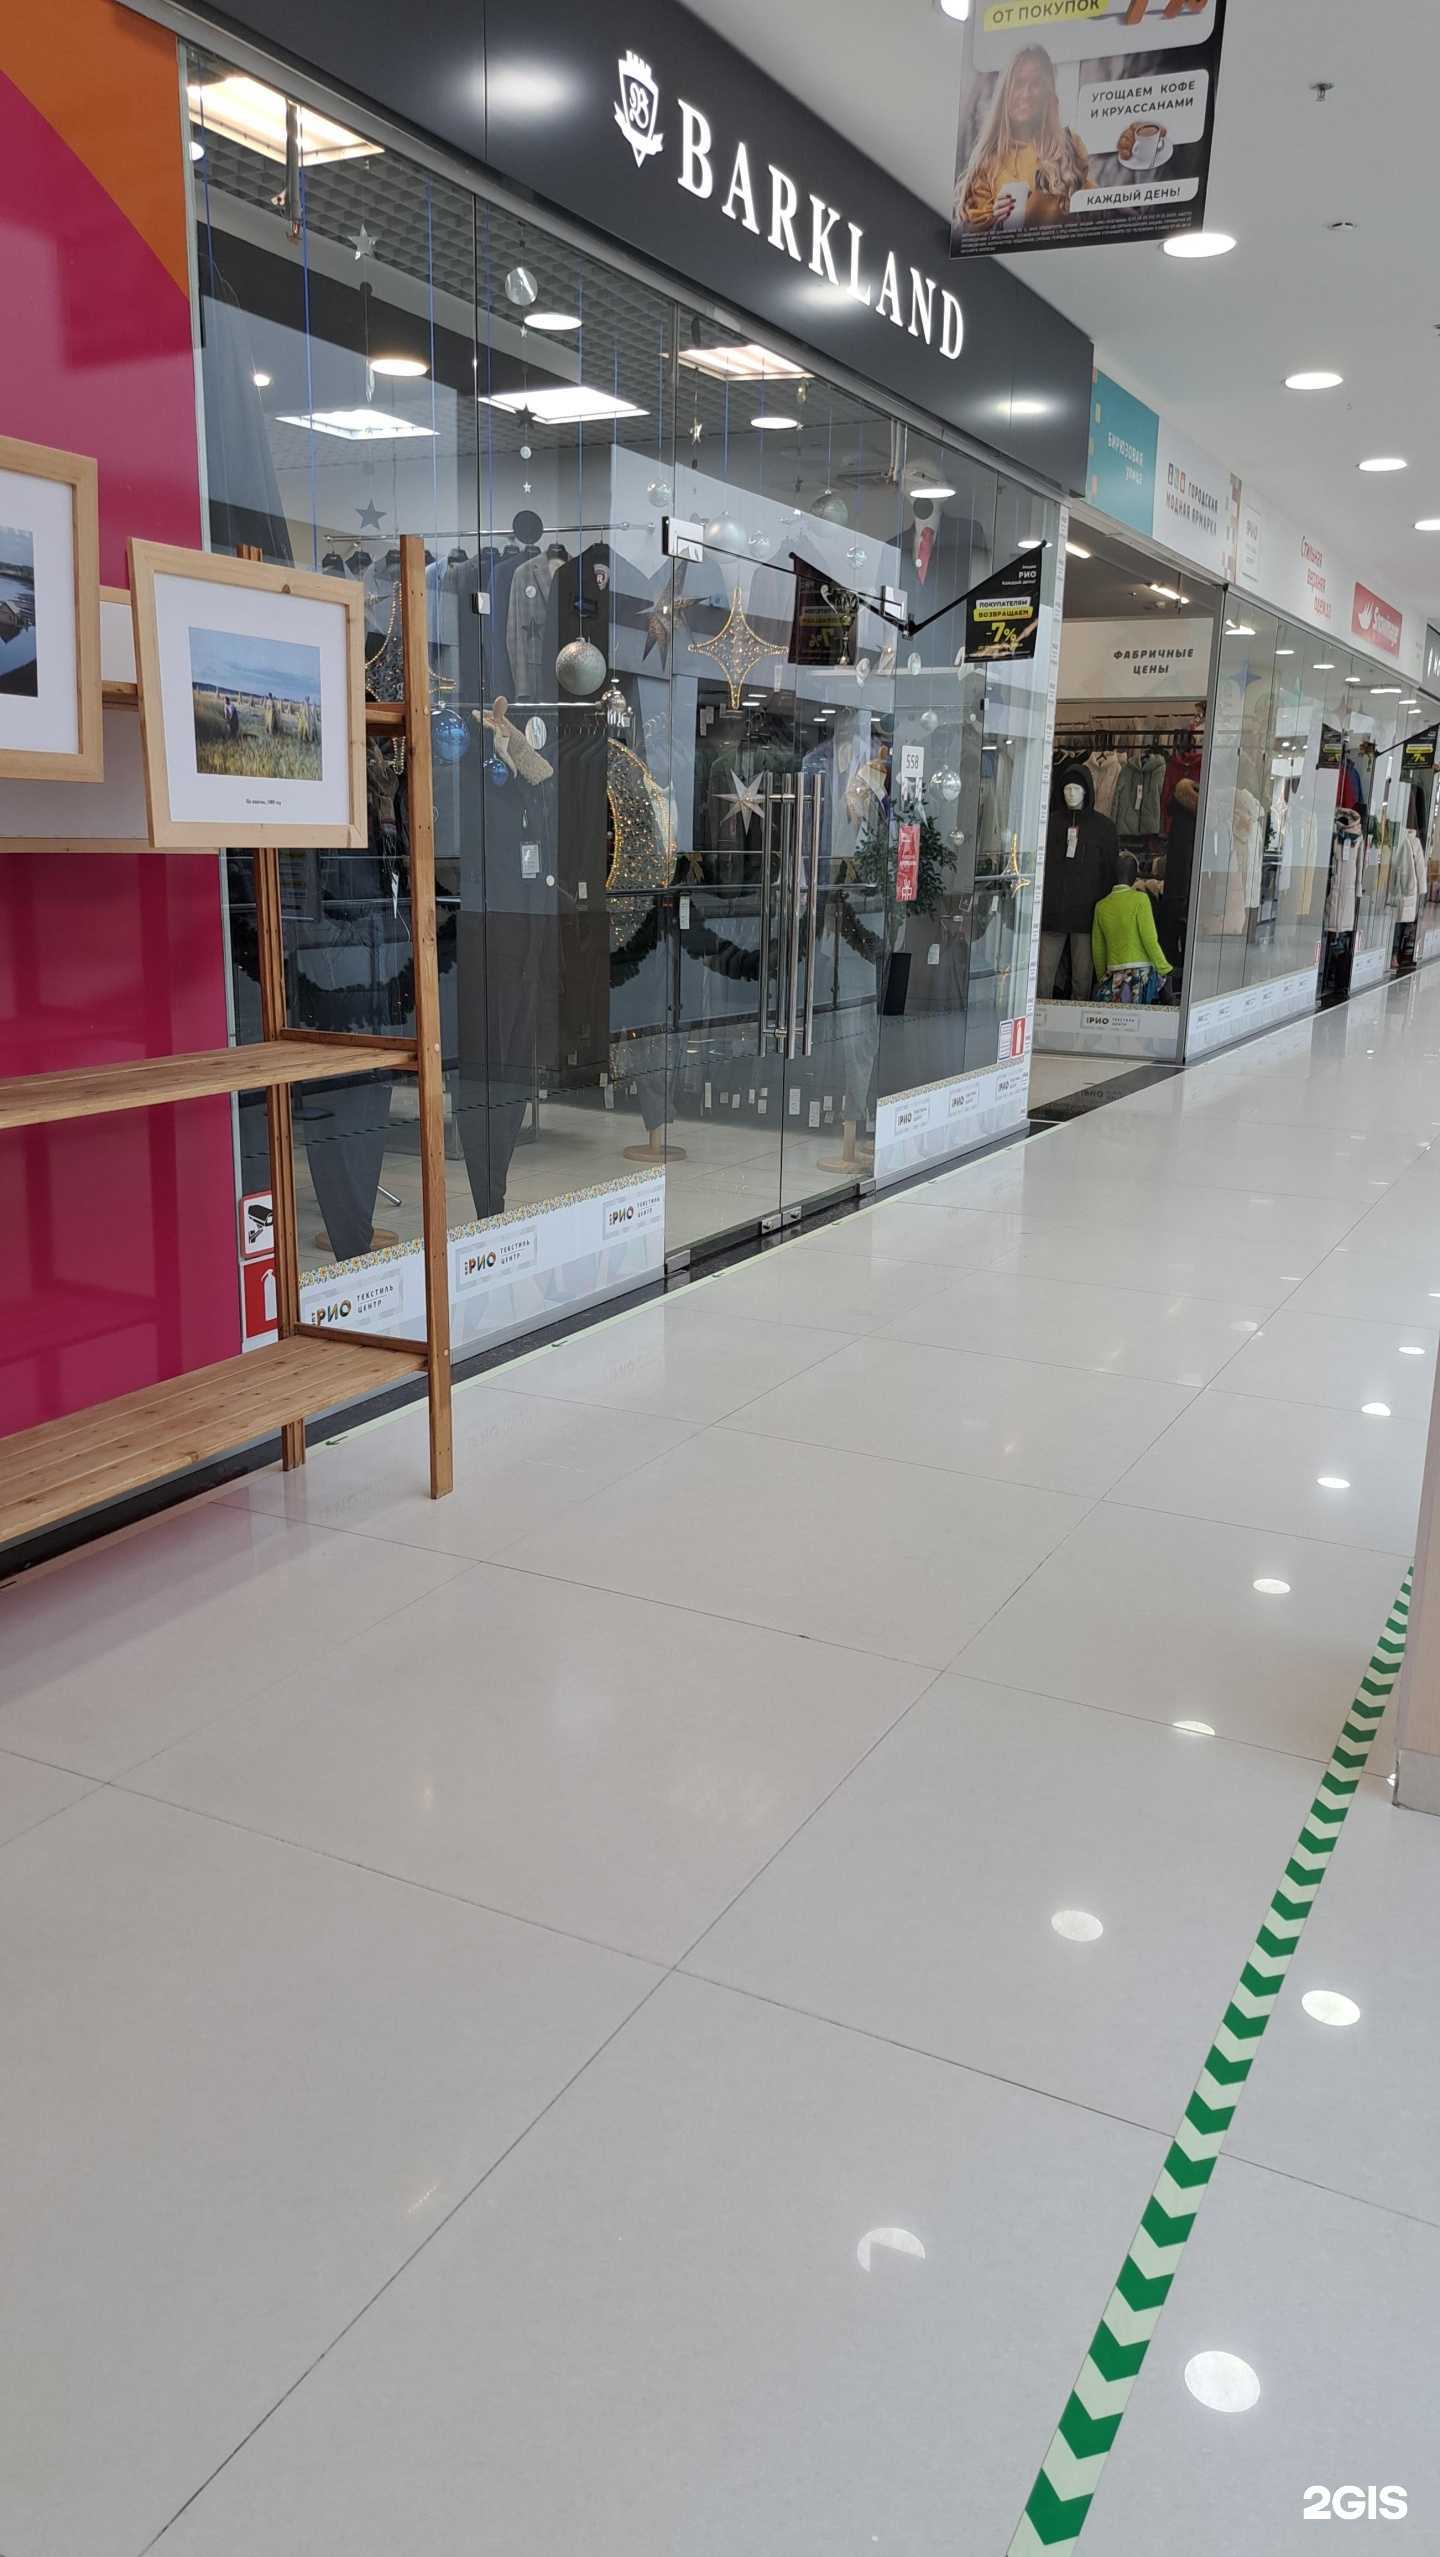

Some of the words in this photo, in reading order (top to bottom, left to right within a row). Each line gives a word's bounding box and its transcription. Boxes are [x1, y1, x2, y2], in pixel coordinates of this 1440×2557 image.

[992, 8, 1015, 24] ОТ
[1018, 0, 1101, 21] ПОКУПОК
[1091, 86, 1153, 103] УГОЩАЕМ
[1160, 80, 1196, 95] КОФЕ
[1090, 109, 1099, 119] И
[1101, 97, 1194, 118] КРУАССАНАМИ
[1086, 189, 1141, 206] КАЖДЫЙ
[1143, 187, 1181, 202] ДЕНЬ!
[677, 98, 964, 361] BARKLAND
[1018, 571, 1037, 579] РИО
[979, 599, 1029, 609] ПОКУПАТЕЛЯМ
[978, 609, 1029, 619] ВОЗВРАЩАЕМ
[1113, 648, 1194, 660] ФАБРИЧНЫЕ
[1132, 664, 1169, 676] ЦЕНЫ
[905, 753, 920, 770] 558
[612, 1205, 634, 1225] РИО
[468, 1251, 497, 1275] РИО
[500, 1239, 530, 1255] ТЕКСТИЛЬ
[316, 1299, 352, 1327] РИО
[356, 1284, 394, 1302] ТЕКСТИЛЬ
[357, 1299, 382, 1314] ЦЕНТР
